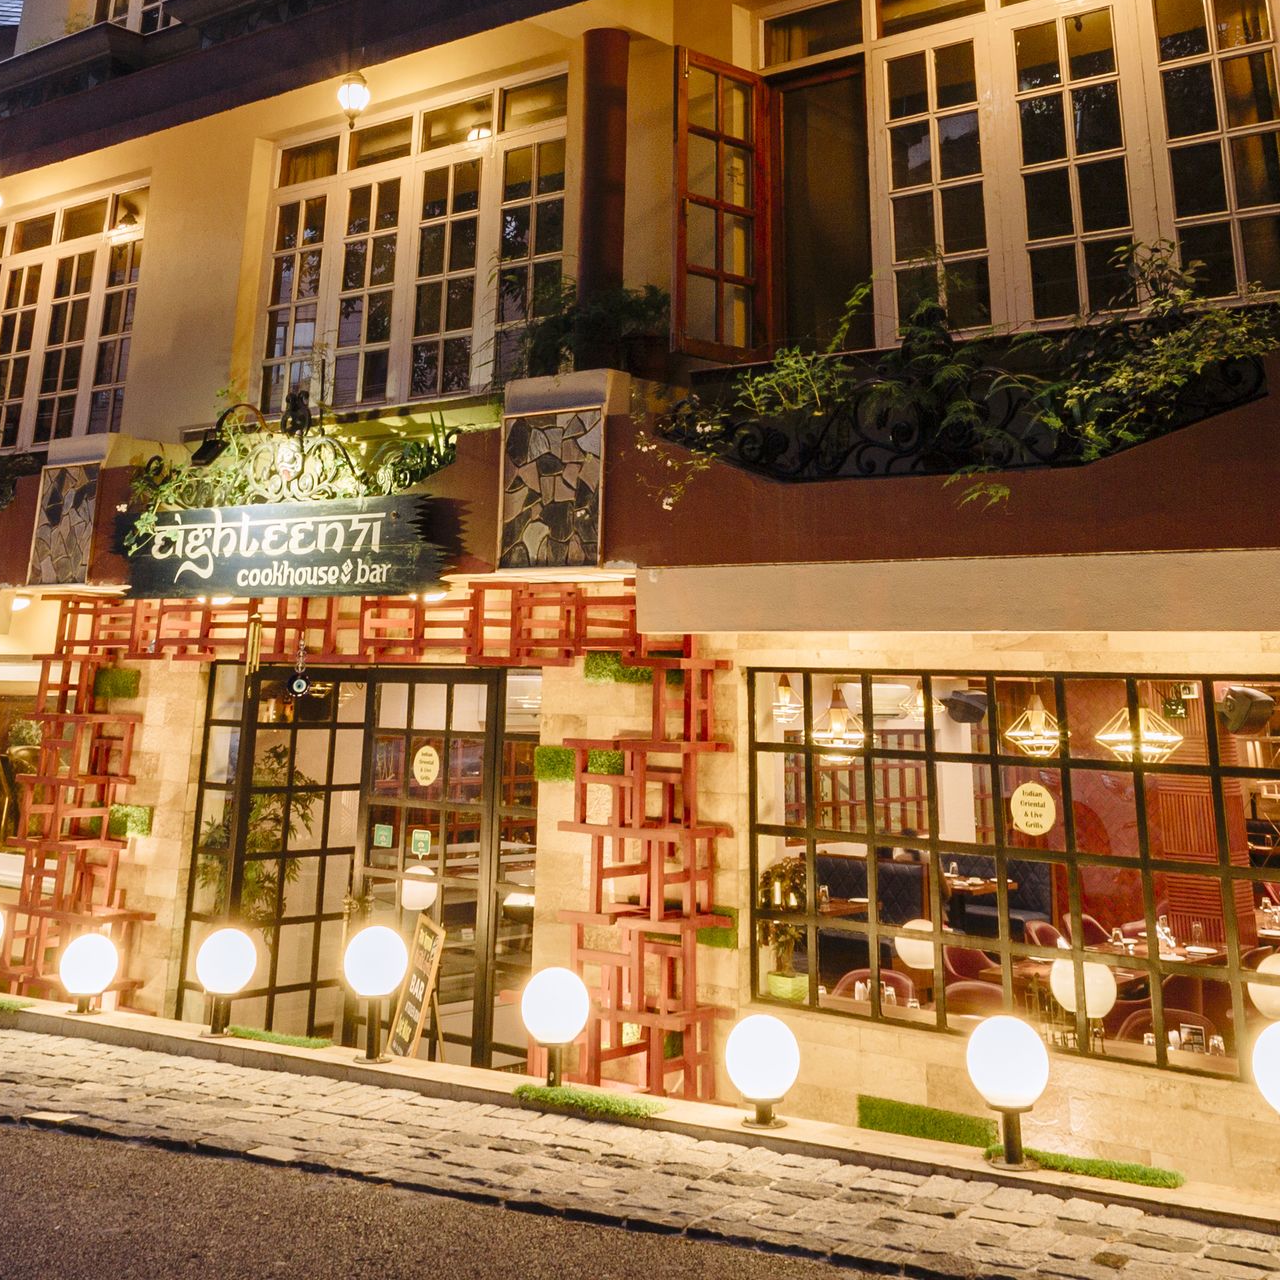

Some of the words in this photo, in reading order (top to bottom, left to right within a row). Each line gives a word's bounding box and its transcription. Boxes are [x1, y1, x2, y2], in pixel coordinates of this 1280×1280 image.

[237, 560, 339, 587] cookhouse
[354, 558, 392, 585] bar
[1022, 790, 1042, 798] Indian
[1020, 800, 1045, 808] Oriental
[1025, 821, 1043, 829] Grills
[409, 973, 425, 1002] BAR
